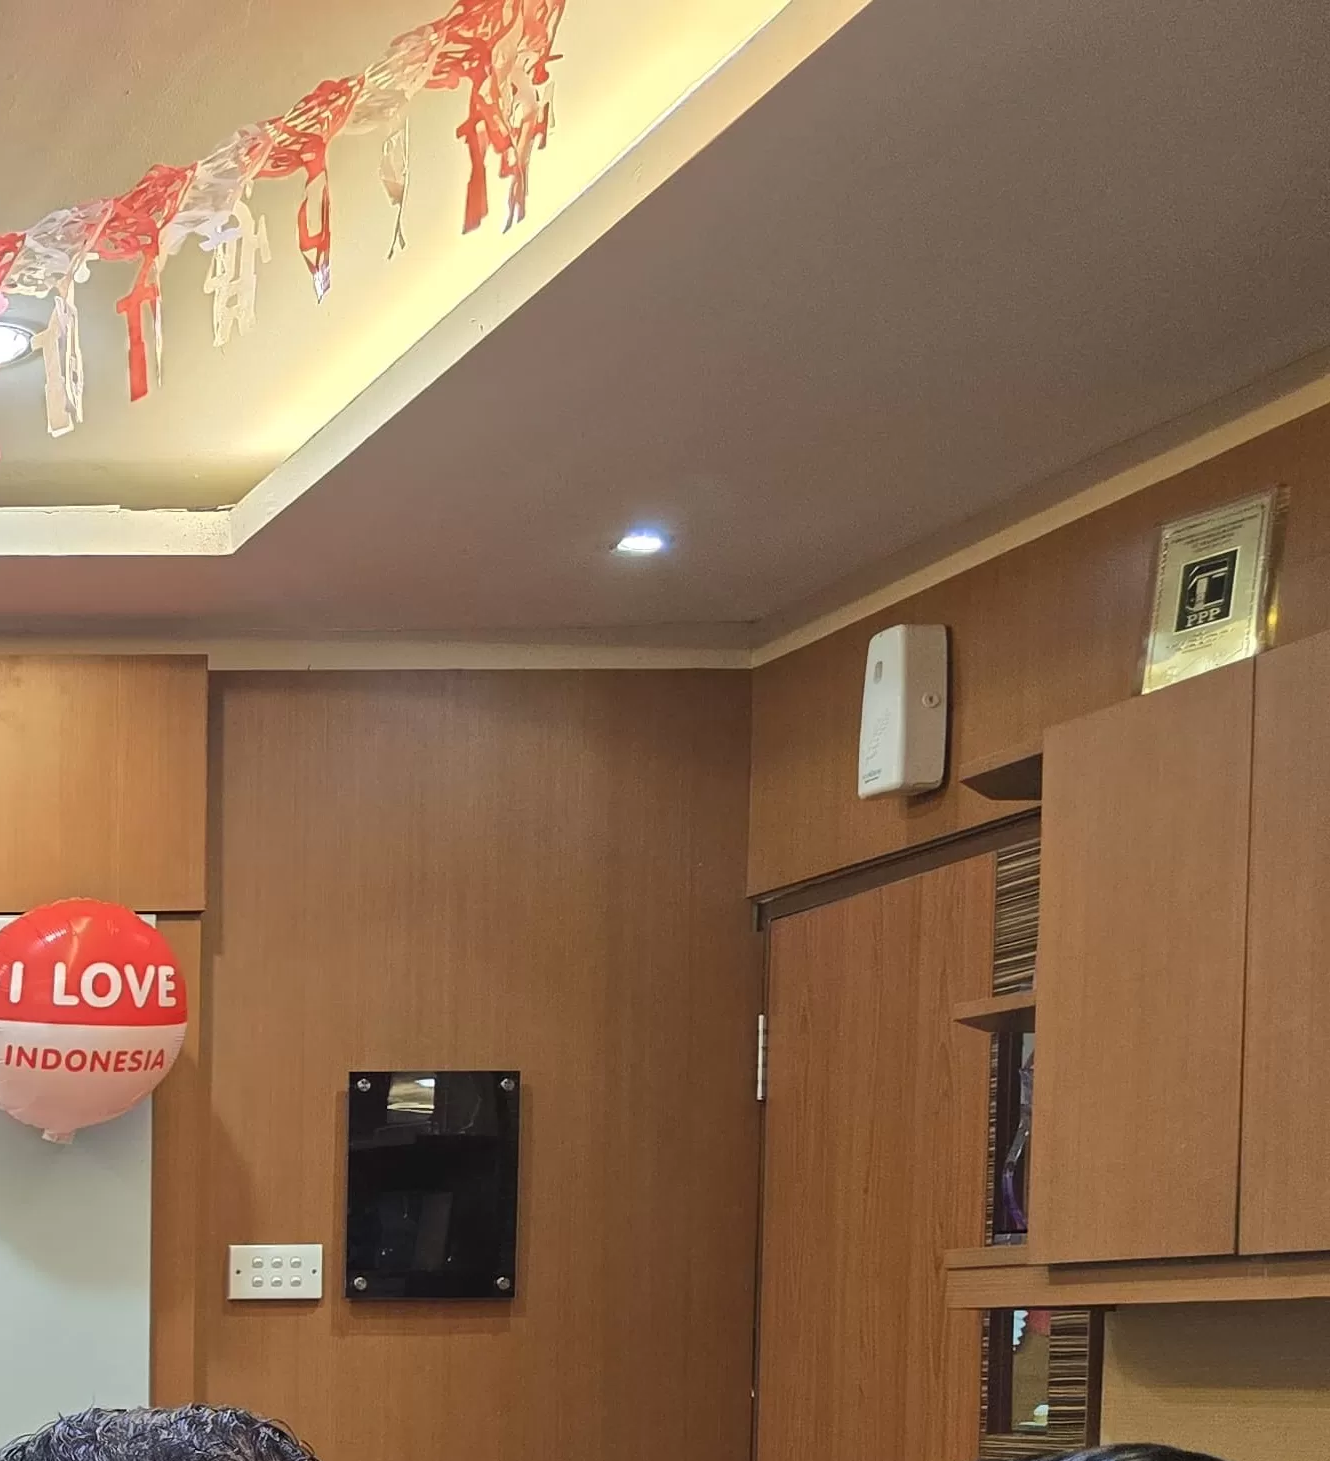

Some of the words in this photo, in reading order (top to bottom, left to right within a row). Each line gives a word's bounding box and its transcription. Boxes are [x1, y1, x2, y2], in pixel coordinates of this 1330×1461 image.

[1186, 607, 1221, 628] PPP
[9, 961, 25, 1004] I
[54, 962, 177, 1008] LOVE
[5, 1044, 165, 1076] INDONESIA
